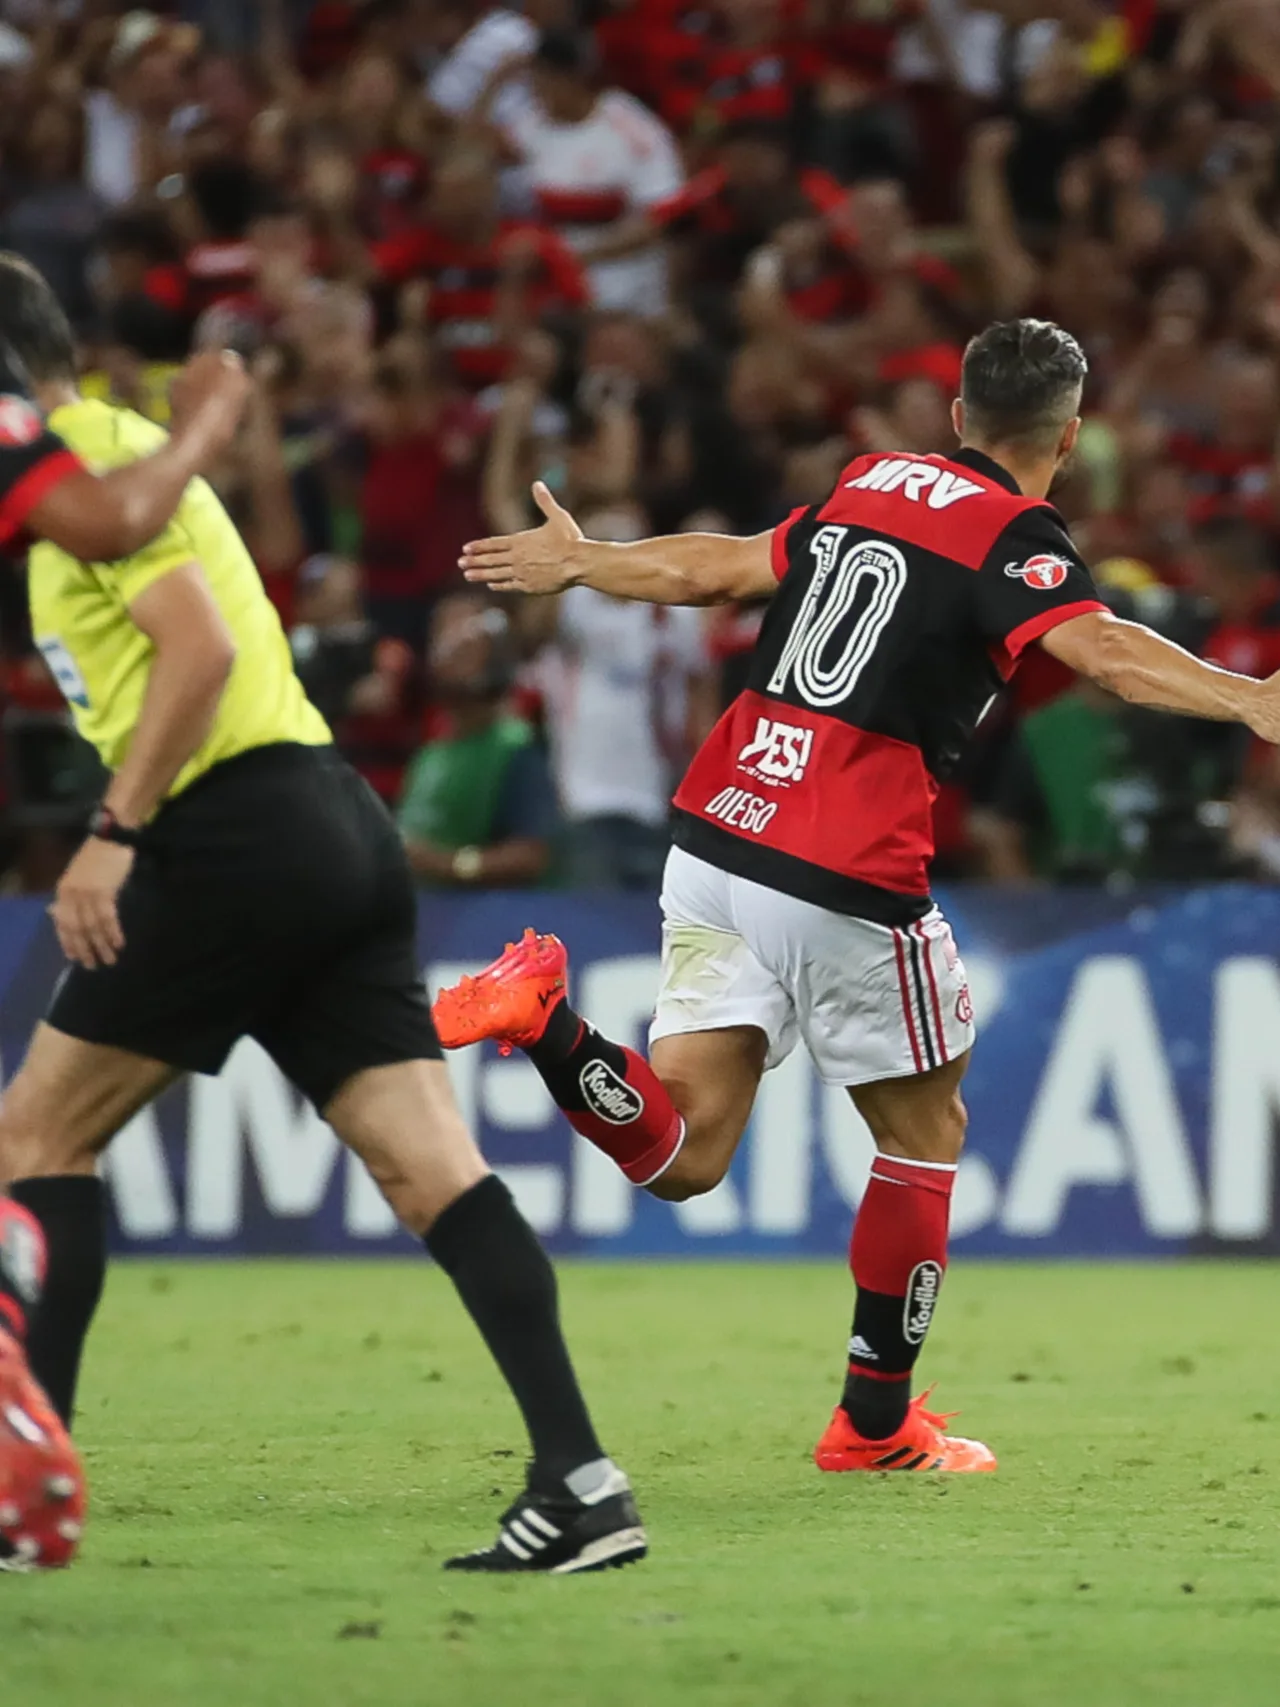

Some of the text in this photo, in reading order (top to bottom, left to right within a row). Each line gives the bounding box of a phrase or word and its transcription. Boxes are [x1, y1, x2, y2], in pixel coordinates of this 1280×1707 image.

[843, 458, 987, 509] MRV
[766, 525, 908, 707] 10
[738, 716, 814, 782] YES!
[704, 786, 778, 834] DIEGO
